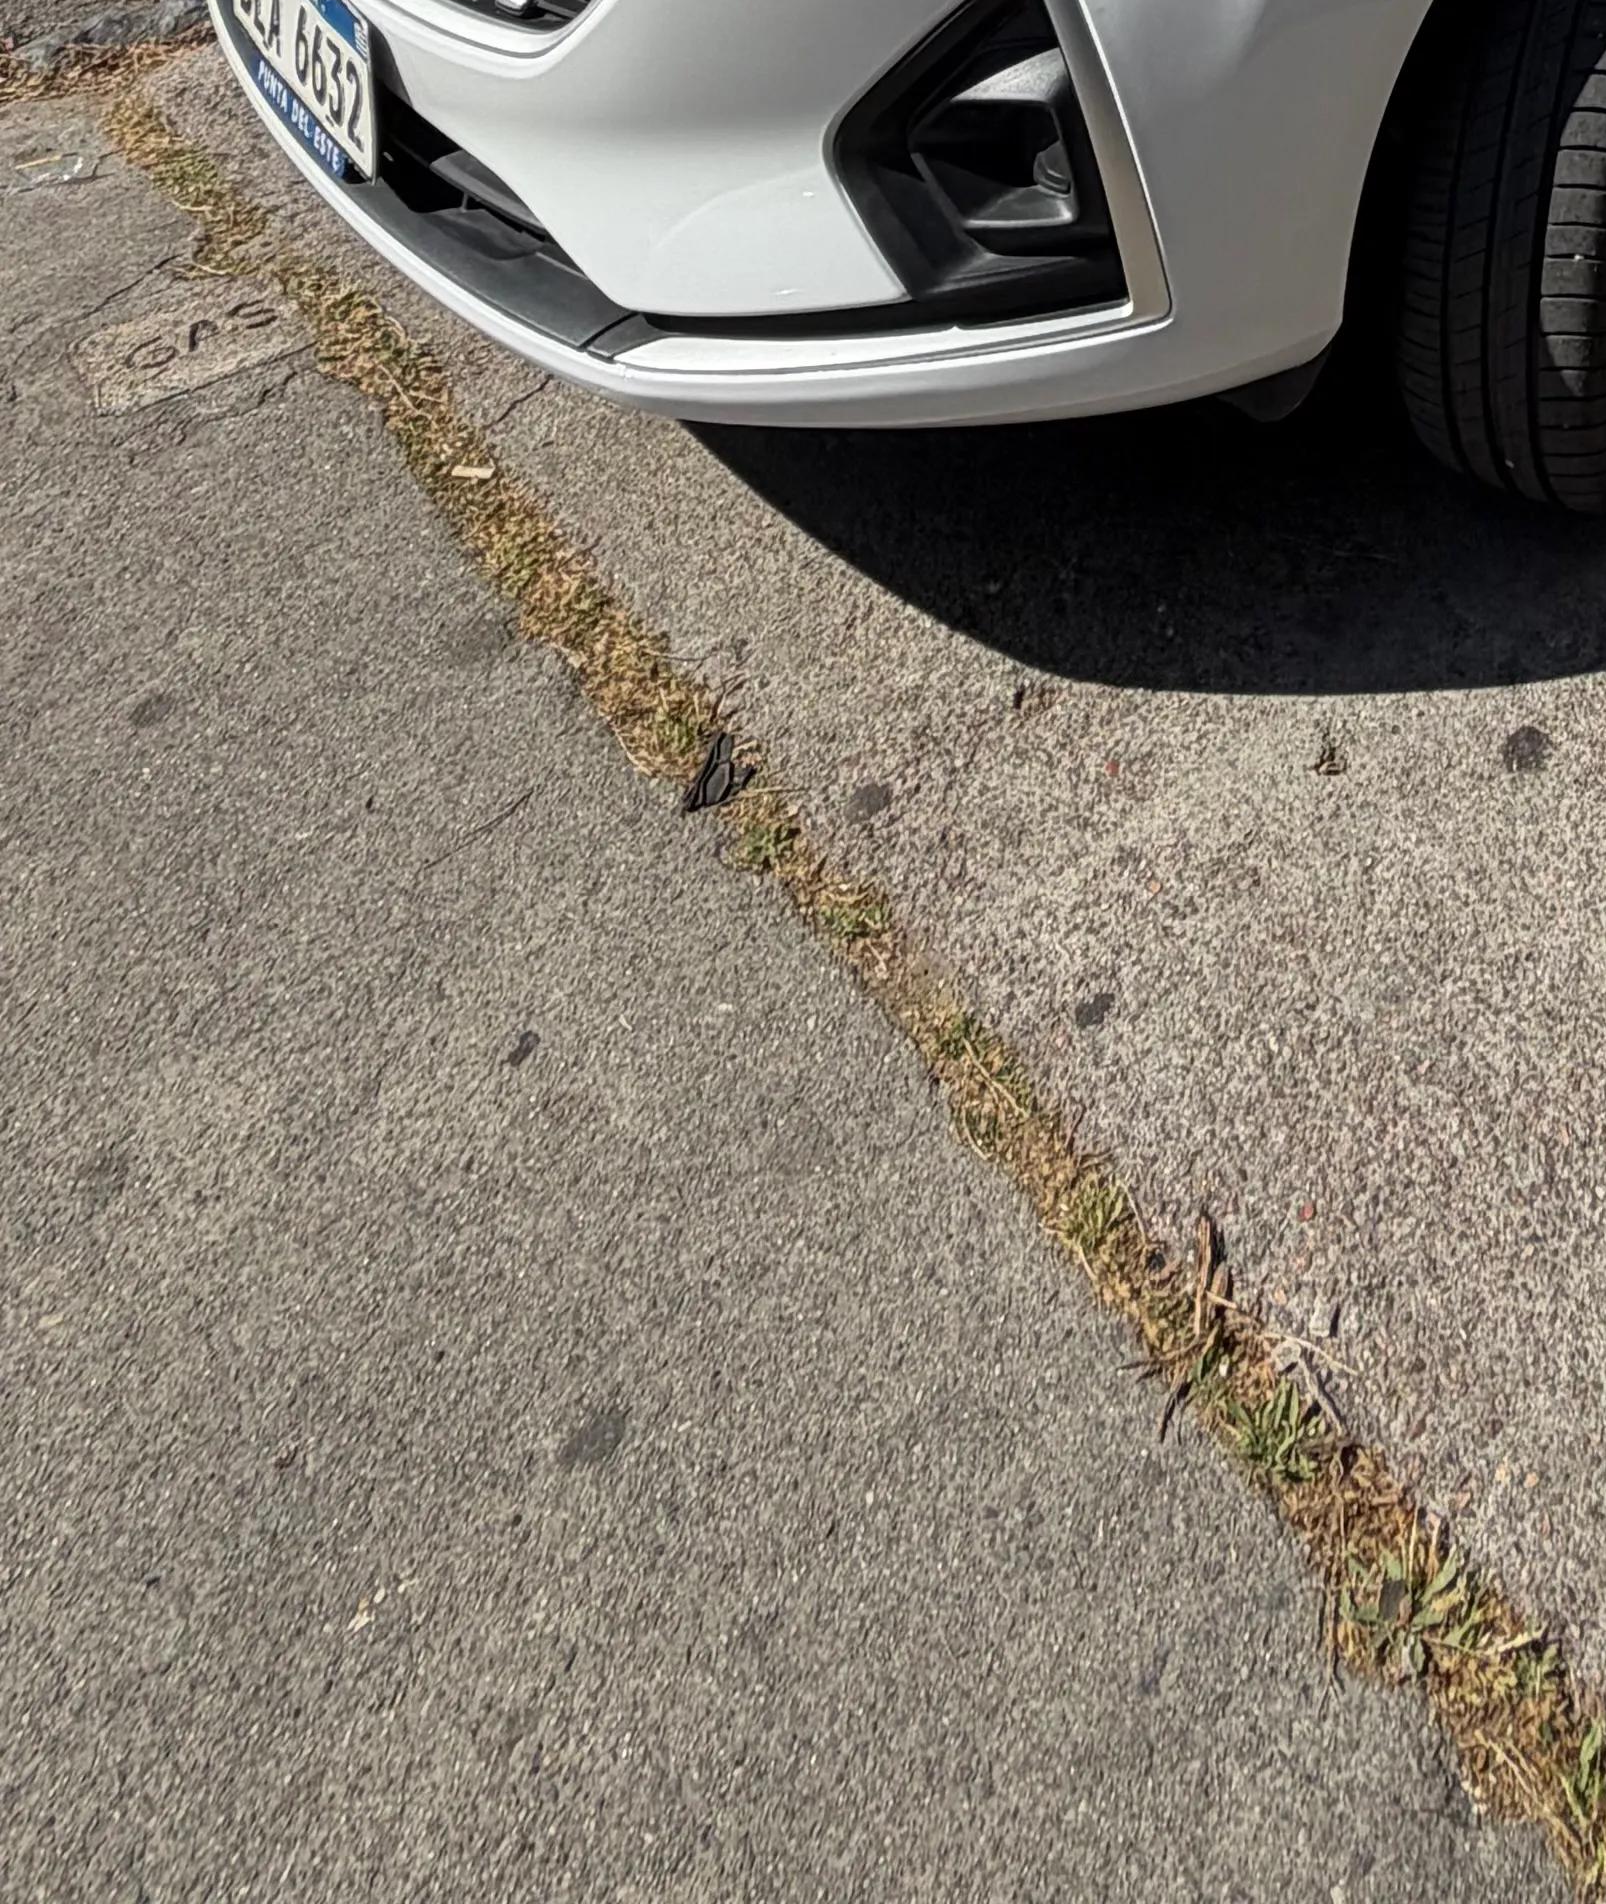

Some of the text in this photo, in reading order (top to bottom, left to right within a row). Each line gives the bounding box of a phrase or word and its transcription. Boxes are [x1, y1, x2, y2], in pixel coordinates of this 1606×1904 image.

[258, 60, 341, 172] PUNTA DEL ESTE
[295, 5, 363, 152] 6632
